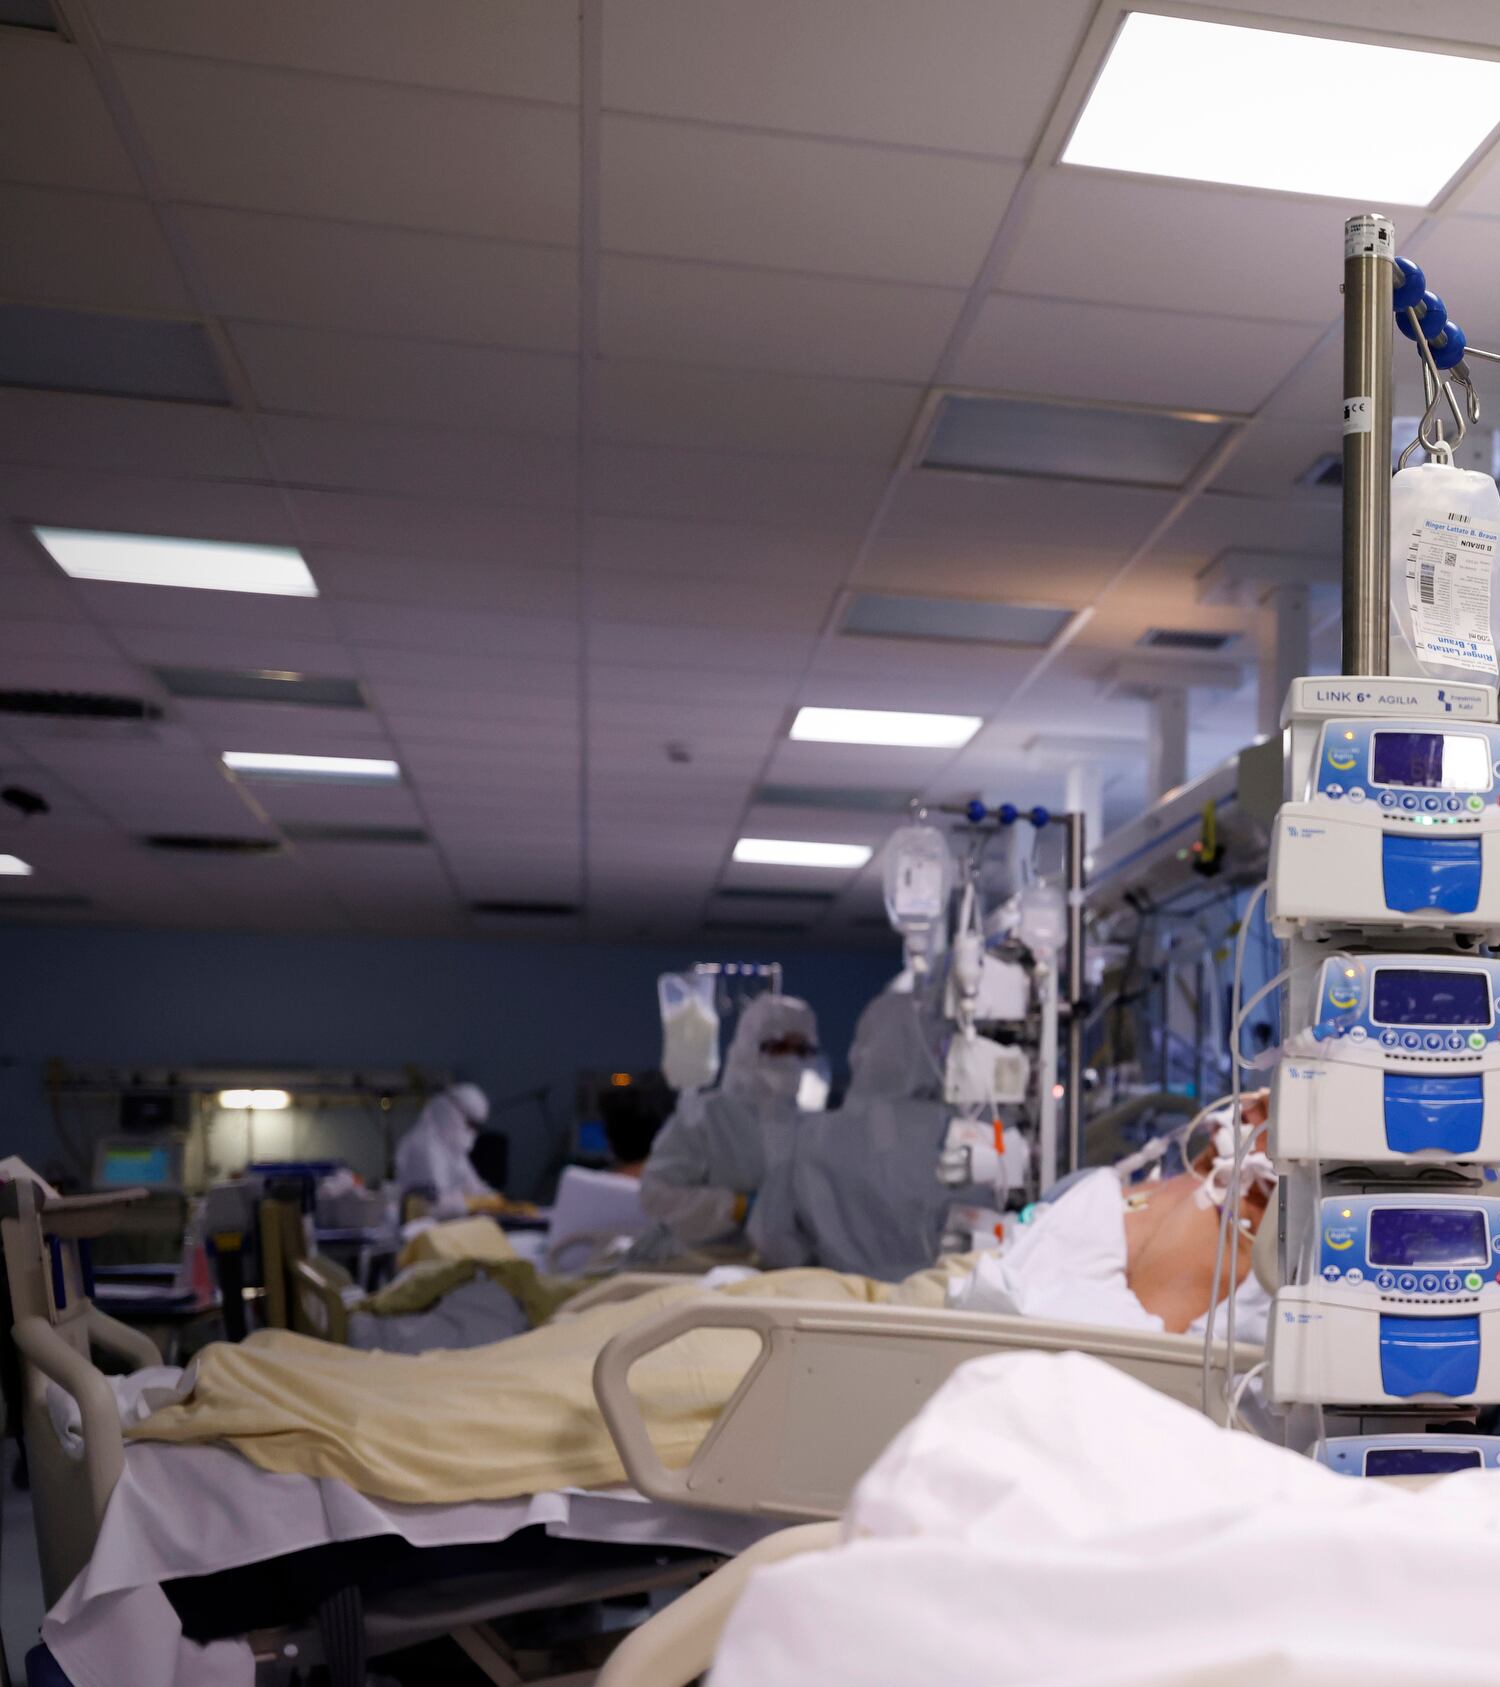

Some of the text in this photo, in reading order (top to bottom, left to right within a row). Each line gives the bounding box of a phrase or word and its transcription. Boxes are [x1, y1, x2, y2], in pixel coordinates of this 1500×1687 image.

[1425, 520, 1445, 530] Ringer
[1446, 525, 1469, 535] Lattato
[1478, 531, 1497, 540] Braun
[1460, 540, 1485, 550] BRAUN
[1438, 636, 1465, 648] Braun
[1427, 643, 1493, 662] Ringer Lattato
[1317, 691, 1351, 702] LINK
[1378, 694, 1418, 705] AGILIA
